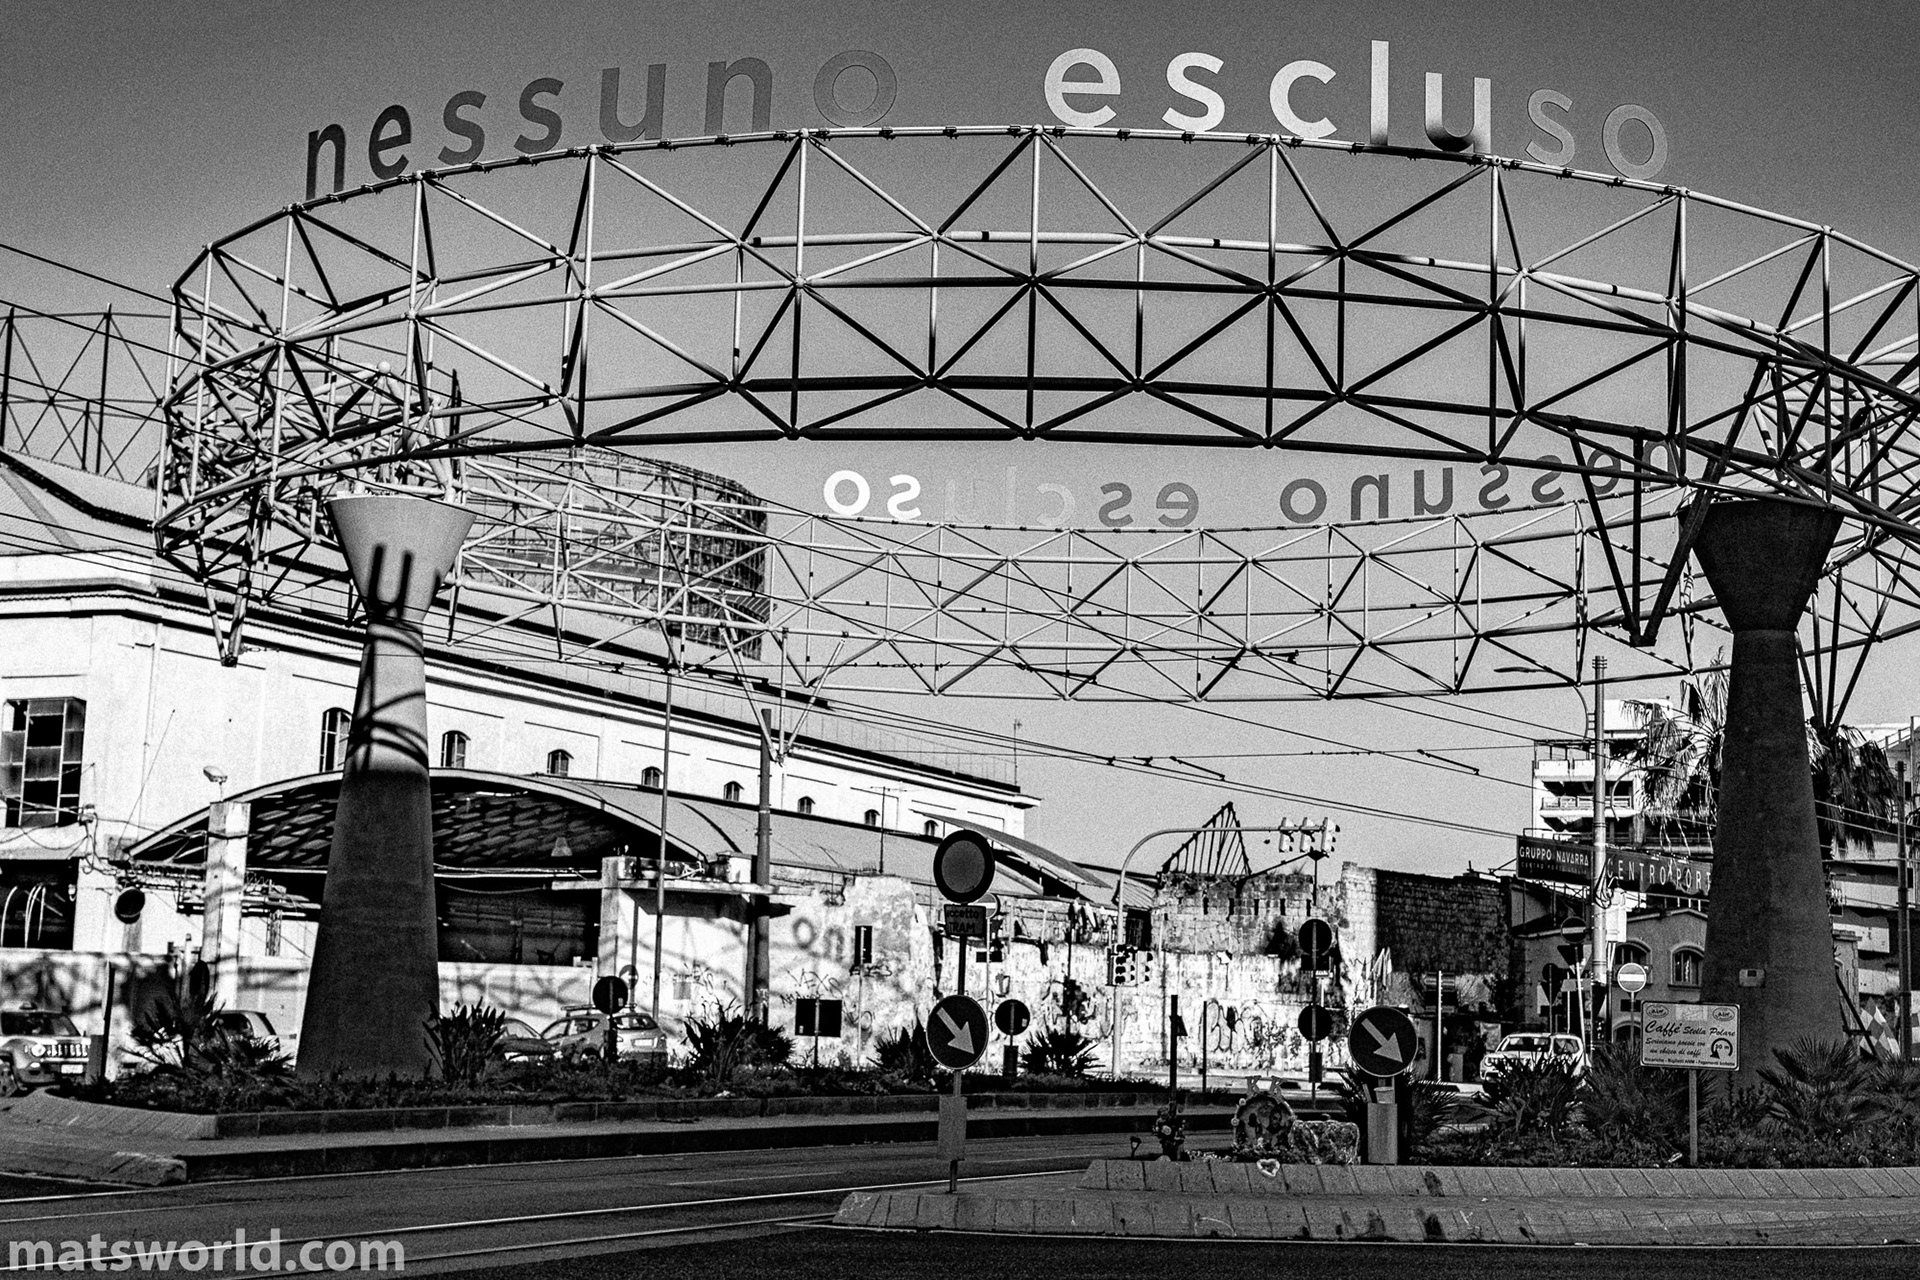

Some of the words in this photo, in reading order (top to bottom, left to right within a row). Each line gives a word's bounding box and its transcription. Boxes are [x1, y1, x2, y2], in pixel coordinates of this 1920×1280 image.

[306, 50, 898, 199] nessuno
[1044, 40, 1669, 179] escluso
[1519, 846, 1552, 861] GRUPPO
[1556, 850, 1589, 866] NAVARRA
[1607, 858, 1666, 885] CENTRO
[949, 921, 975, 933] TRAM
[1682, 1026, 1706, 1035] Stella
[1709, 1027, 1736, 1037] Polare
